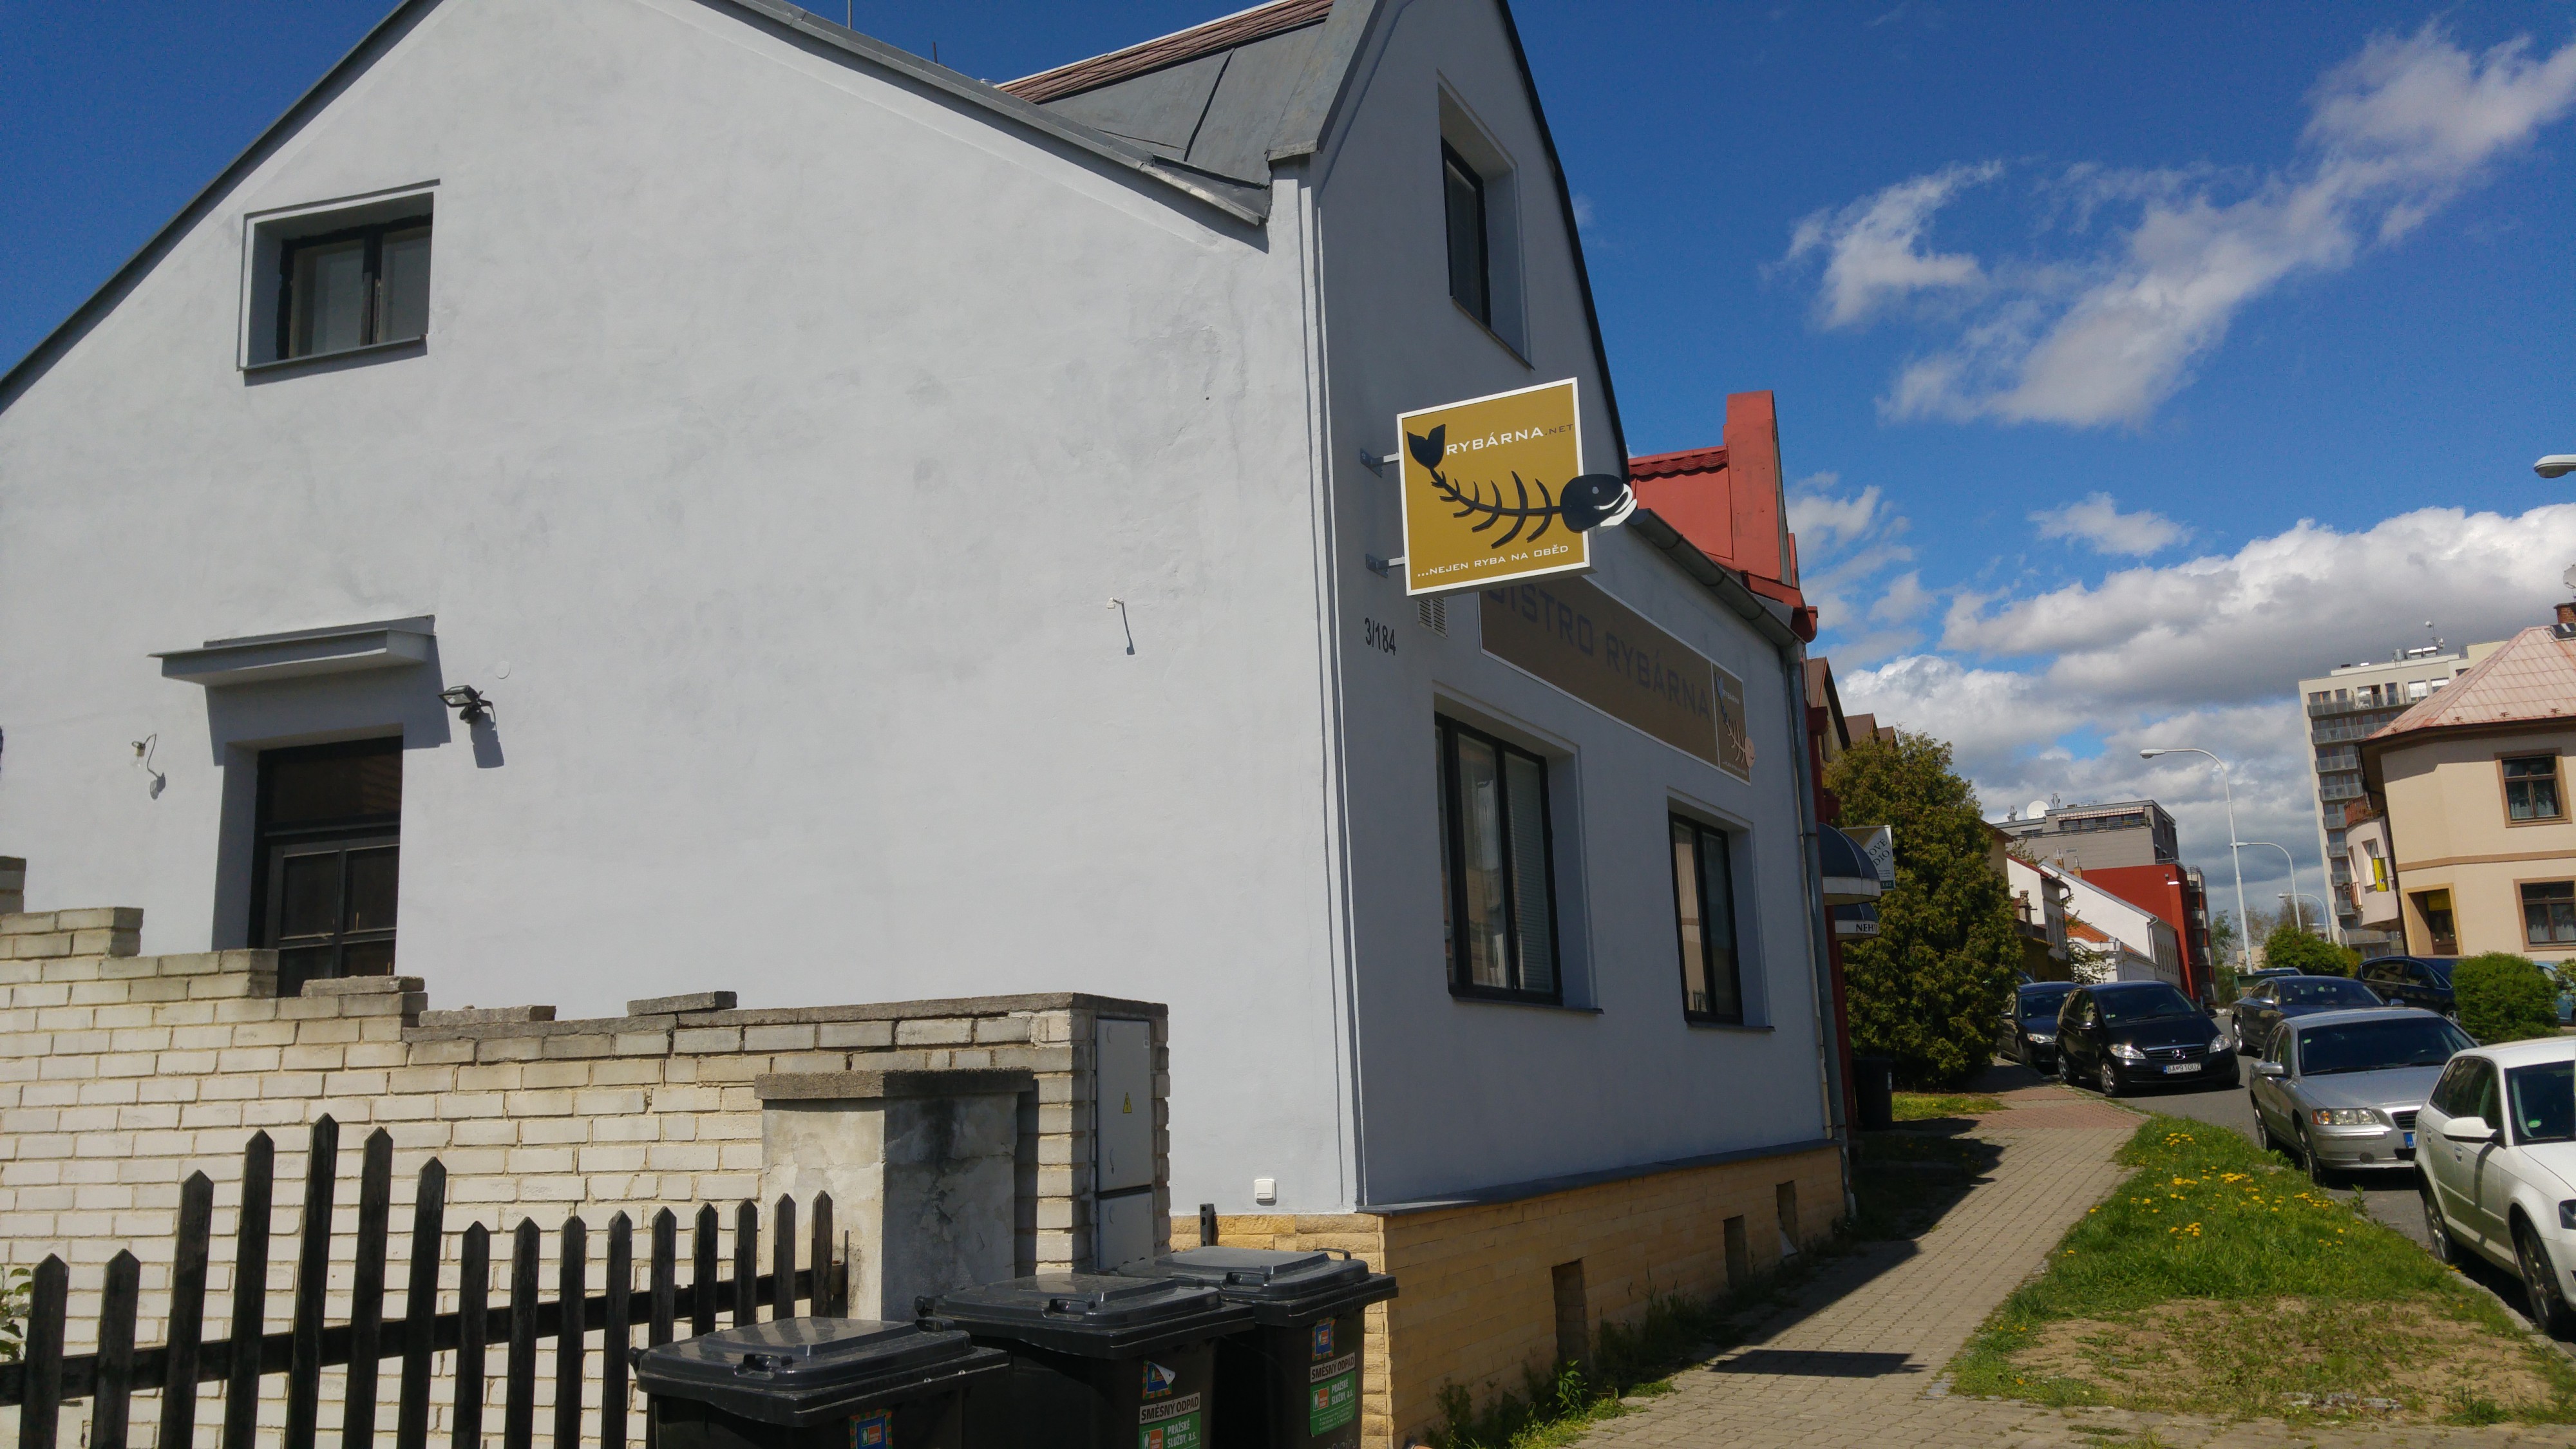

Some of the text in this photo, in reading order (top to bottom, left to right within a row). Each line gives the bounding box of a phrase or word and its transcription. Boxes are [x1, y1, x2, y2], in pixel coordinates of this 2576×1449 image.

[1417, 544, 1569, 577] ...NEJEN RYBA NA OBĚD
[1365, 617, 1396, 656] 3/184
[1606, 630, 1711, 723] RYBÁRNA
[1311, 1356, 1354, 1379] SMĚSNÝ ODPAD
[1332, 1378, 1348, 1394] PRAŽSKÉ
[1141, 1396, 1198, 1421] SMĚSNÝ ODPAD
[1168, 1417, 1190, 1435] PRAŽSKÉ
[1167, 1433, 1187, 1448] SLUŽBY,
